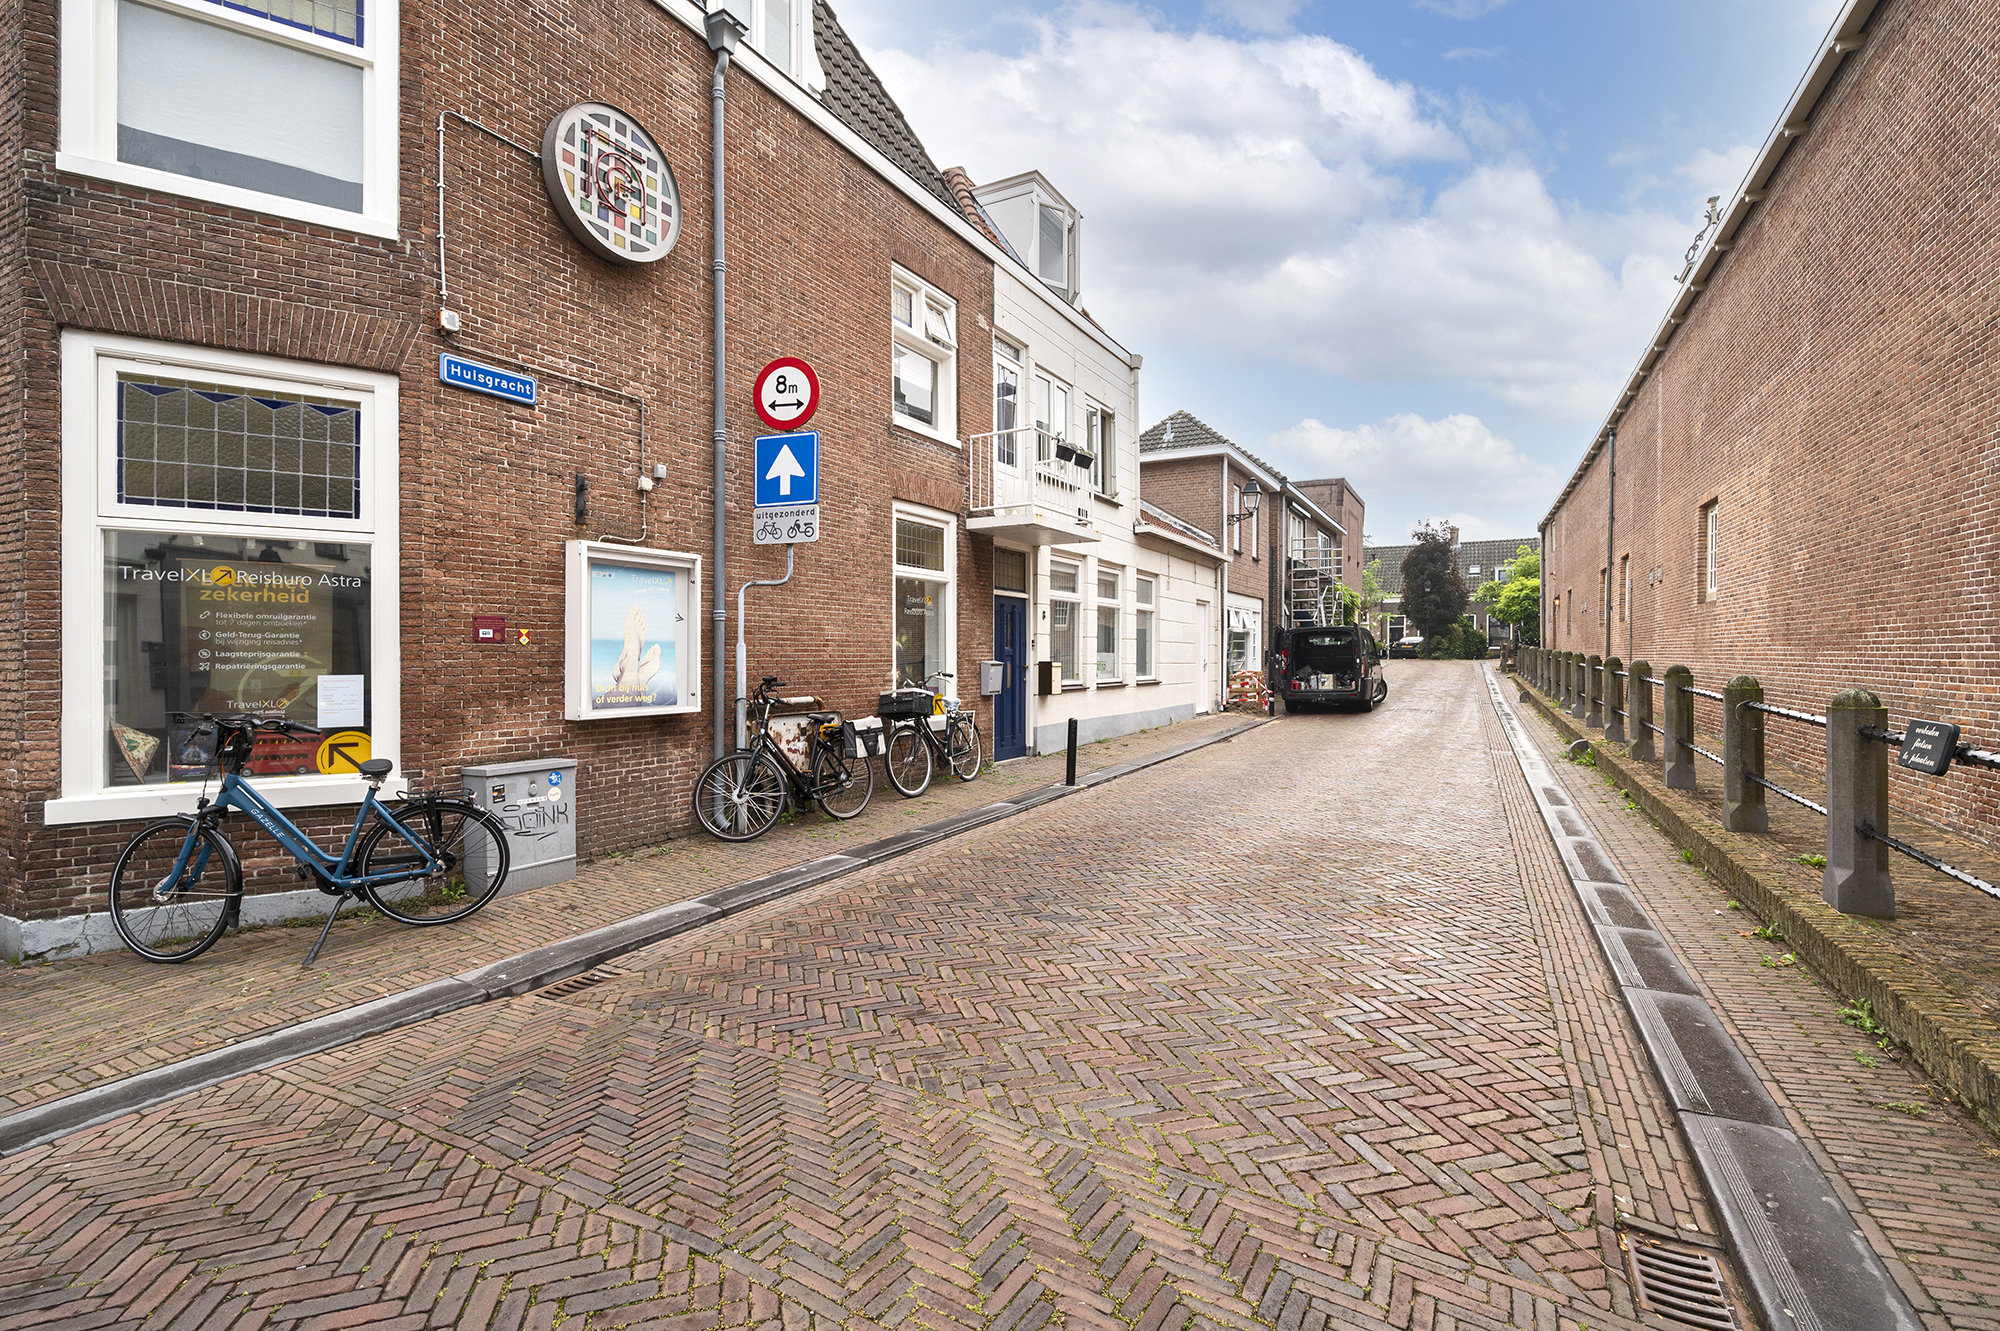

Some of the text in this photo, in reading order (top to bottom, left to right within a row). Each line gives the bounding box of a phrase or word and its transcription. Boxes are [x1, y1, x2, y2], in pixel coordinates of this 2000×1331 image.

[451, 364, 532, 395] Huisgracht
[756, 507, 815, 521] uitgezonderd
[118, 565, 362, 588] TravelXL Reisburo Astra
[631, 574, 664, 586] TravelXL
[200, 587, 310, 603] zekerheid
[256, 613, 317, 621] omruilgarantie
[215, 631, 300, 639] Geld-Terug-Garantie
[215, 663, 306, 671] Repatriëringsgarantie
[596, 683, 649, 694] Dicht bij huis
[596, 693, 657, 704] of verder weg?
[226, 700, 276, 709] TravelXL
[250, 808, 286, 838] GAZELLE
